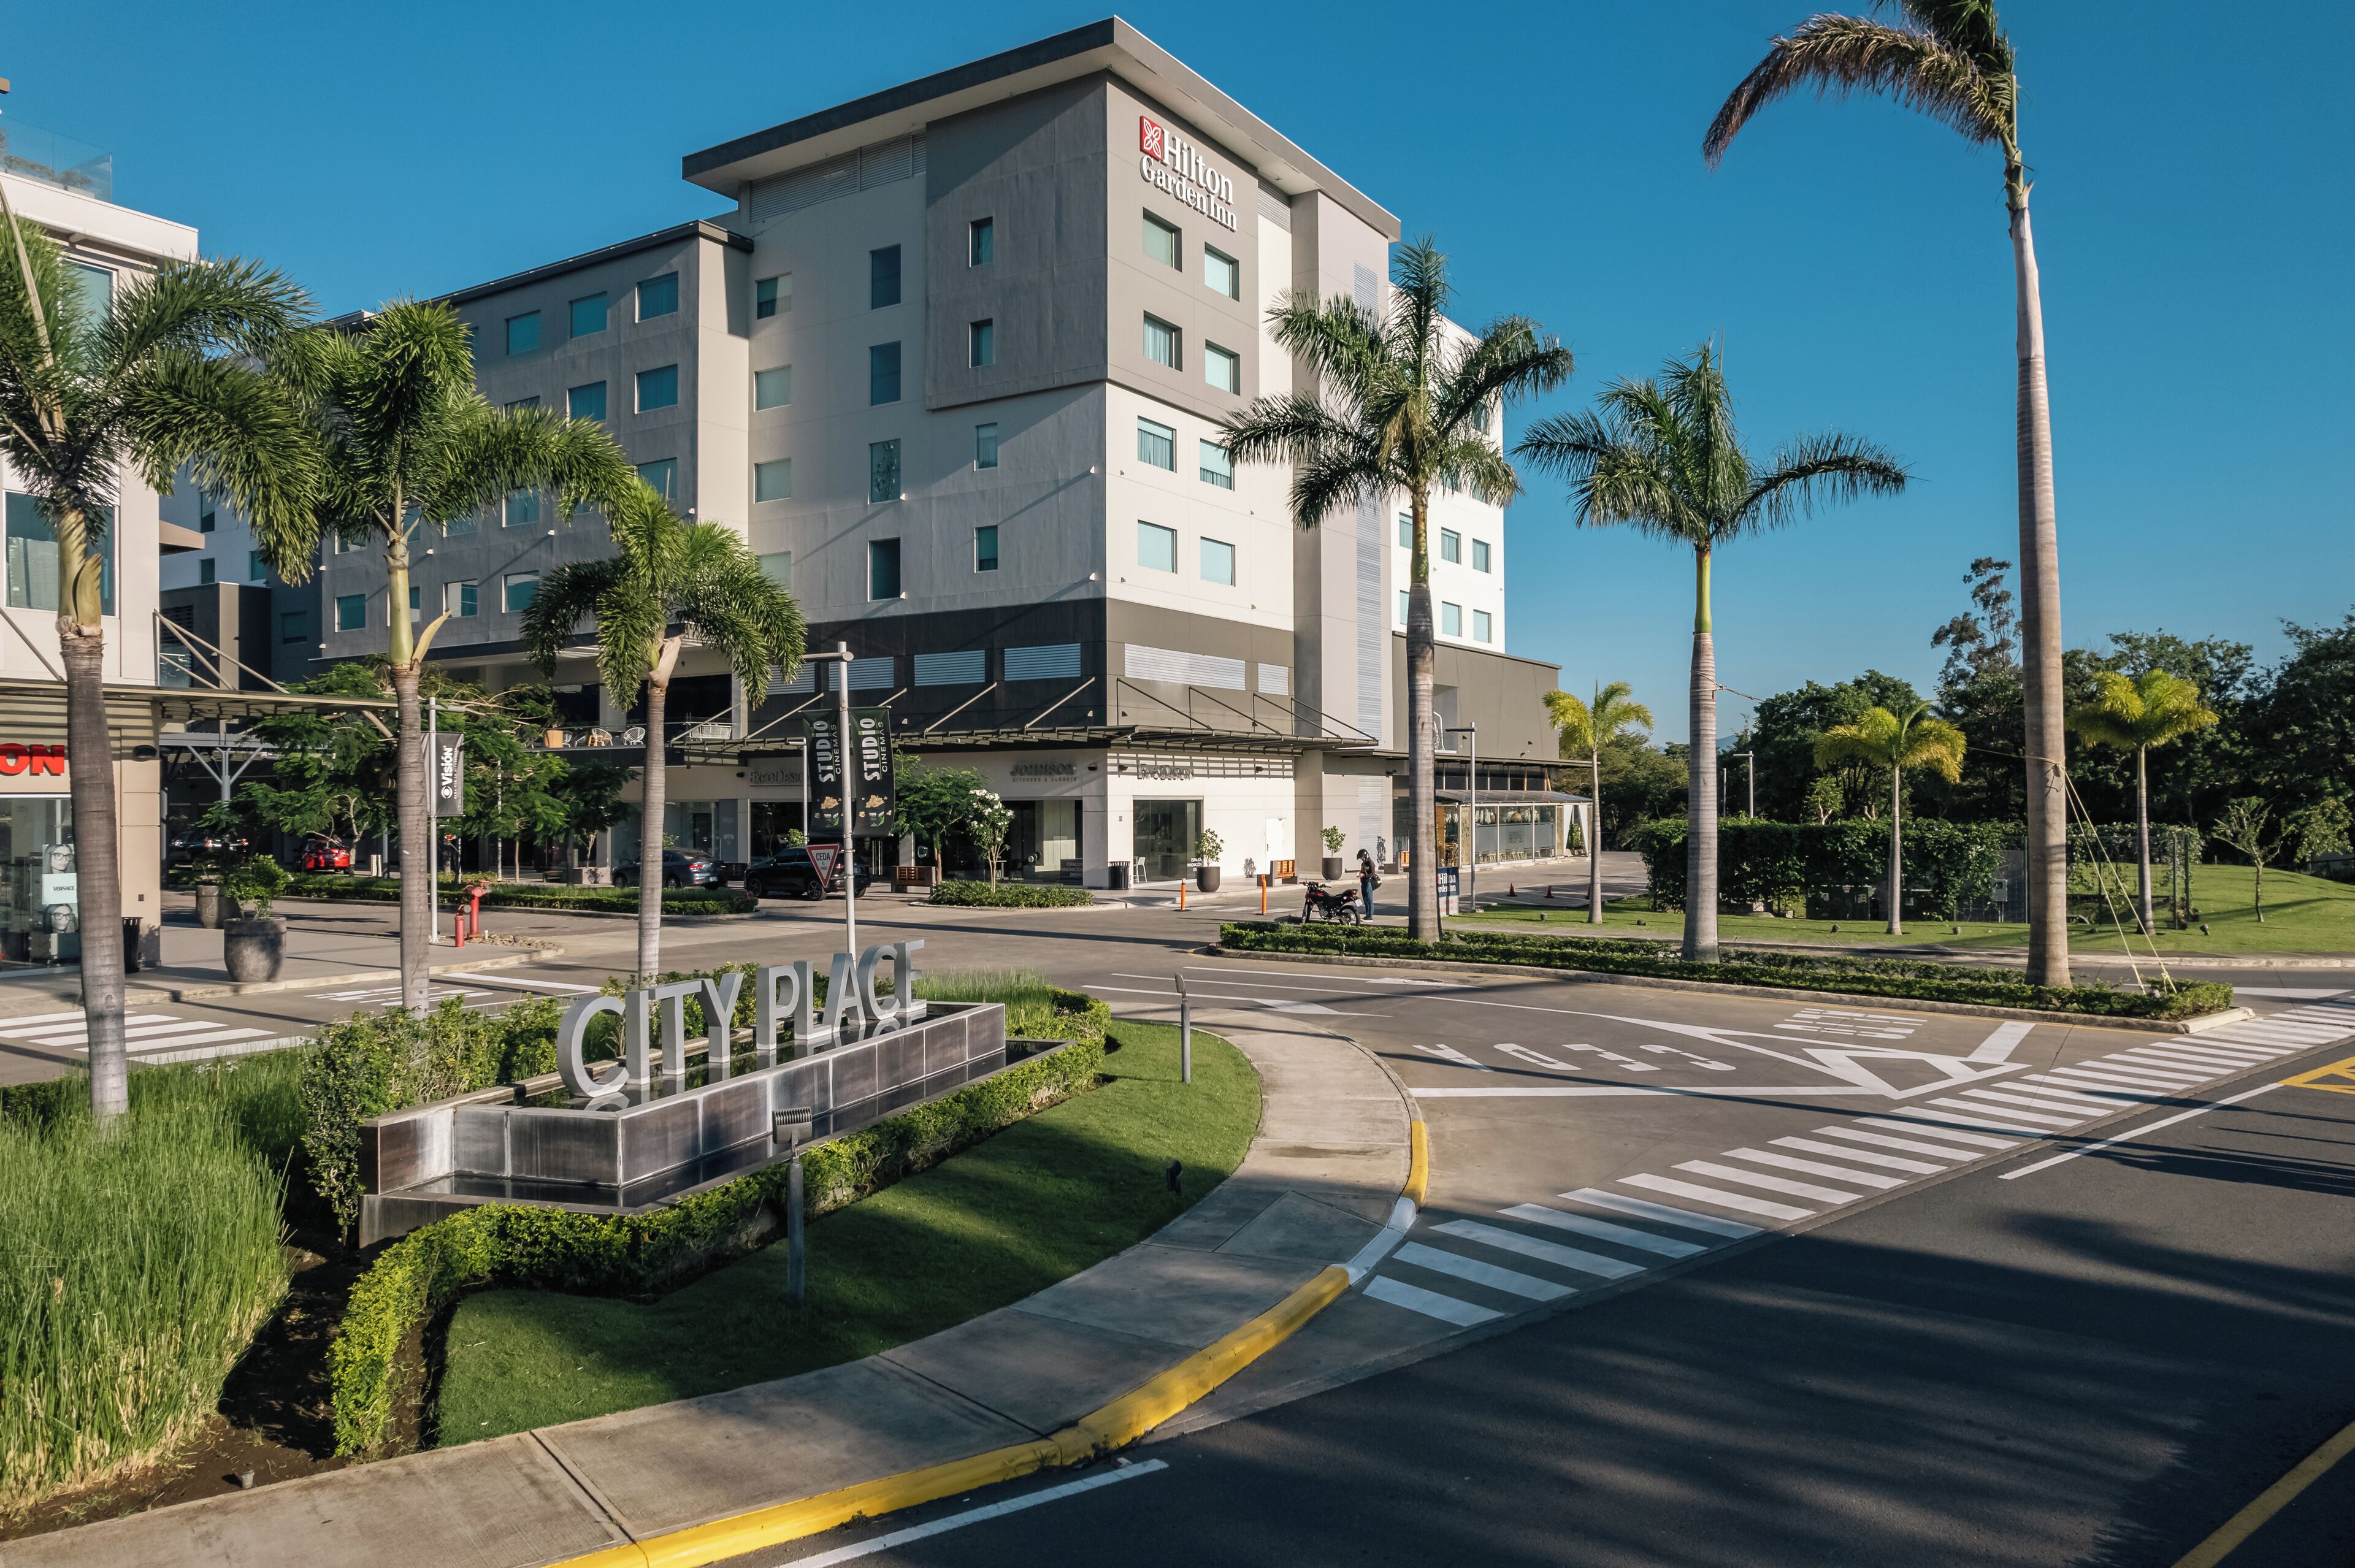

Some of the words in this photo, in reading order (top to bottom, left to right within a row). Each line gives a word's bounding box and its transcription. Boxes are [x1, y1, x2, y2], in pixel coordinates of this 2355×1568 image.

[1162, 128, 1234, 205] Hilton
[1140, 155, 1208, 215] Garden
[1206, 193, 1238, 232] Inn
[0, 743, 65, 776] ON
[812, 720, 834, 782] STUDIO
[830, 724, 841, 774] CINEMAS
[858, 718, 880, 781] STUDIO
[878, 721, 887, 773] CINEMAS
[1010, 763, 1074, 776] JOHNSON
[816, 852, 830, 861] CEDA
[1439, 873, 1456, 884] Hilton
[556, 973, 744, 1097] CITY
[756, 939, 927, 1050] PLACE
[1412, 1043, 1737, 1073] CEDA
